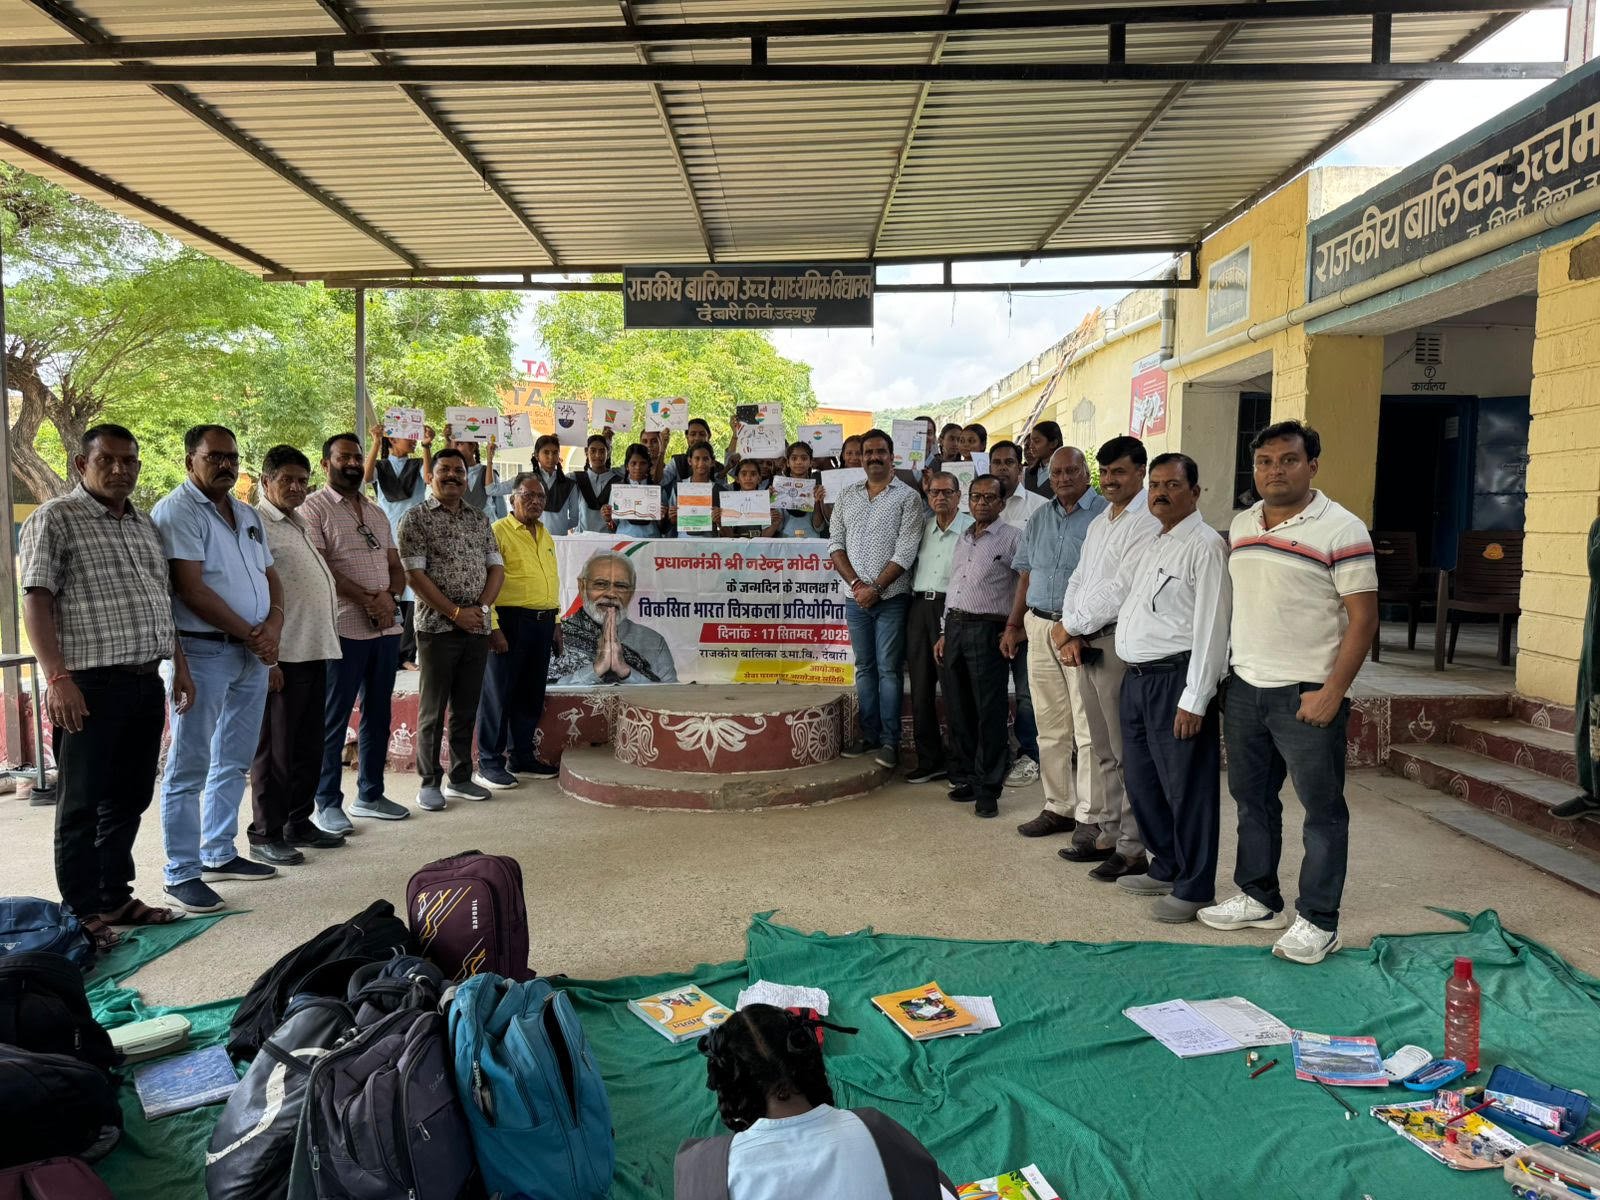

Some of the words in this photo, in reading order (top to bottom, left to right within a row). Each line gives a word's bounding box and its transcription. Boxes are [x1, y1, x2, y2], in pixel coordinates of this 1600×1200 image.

[1315, 205, 1402, 282] राजकीय
[1402, 164, 1509, 241] बालिका
[627, 271, 682, 301] राजकीय
[685, 270, 740, 301] बालिका
[740, 276, 770, 300] उच्च
[696, 302, 743, 322] देबारी
[1410, 379, 1447, 391] कार्यालय
[654, 552, 722, 572] प्रधानमंत्री
[725, 554, 743, 571] श्री
[746, 555, 784, 573] नरेन्द्र
[787, 553, 820, 571] मोदी
[822, 559, 837, 570] ज
[726, 579, 737, 593] के
[740, 579, 780, 593] जन्मदिन
[783, 579, 793, 593] के
[795, 582, 829, 594] उपलक्ष
[831, 579, 842, 593] में
[638, 597, 691, 617] विकसित
[694, 602, 725, 618] भारत
[727, 599, 781, 619] चित्रकला
[783, 599, 845, 620] प्रतियोगित
[717, 626, 751, 640] दिनांक
[762, 629, 775, 640] 17
[821, 629, 849, 641] 2025
[699, 647, 737, 659] राजकीय
[740, 647, 777, 659] बालिका
